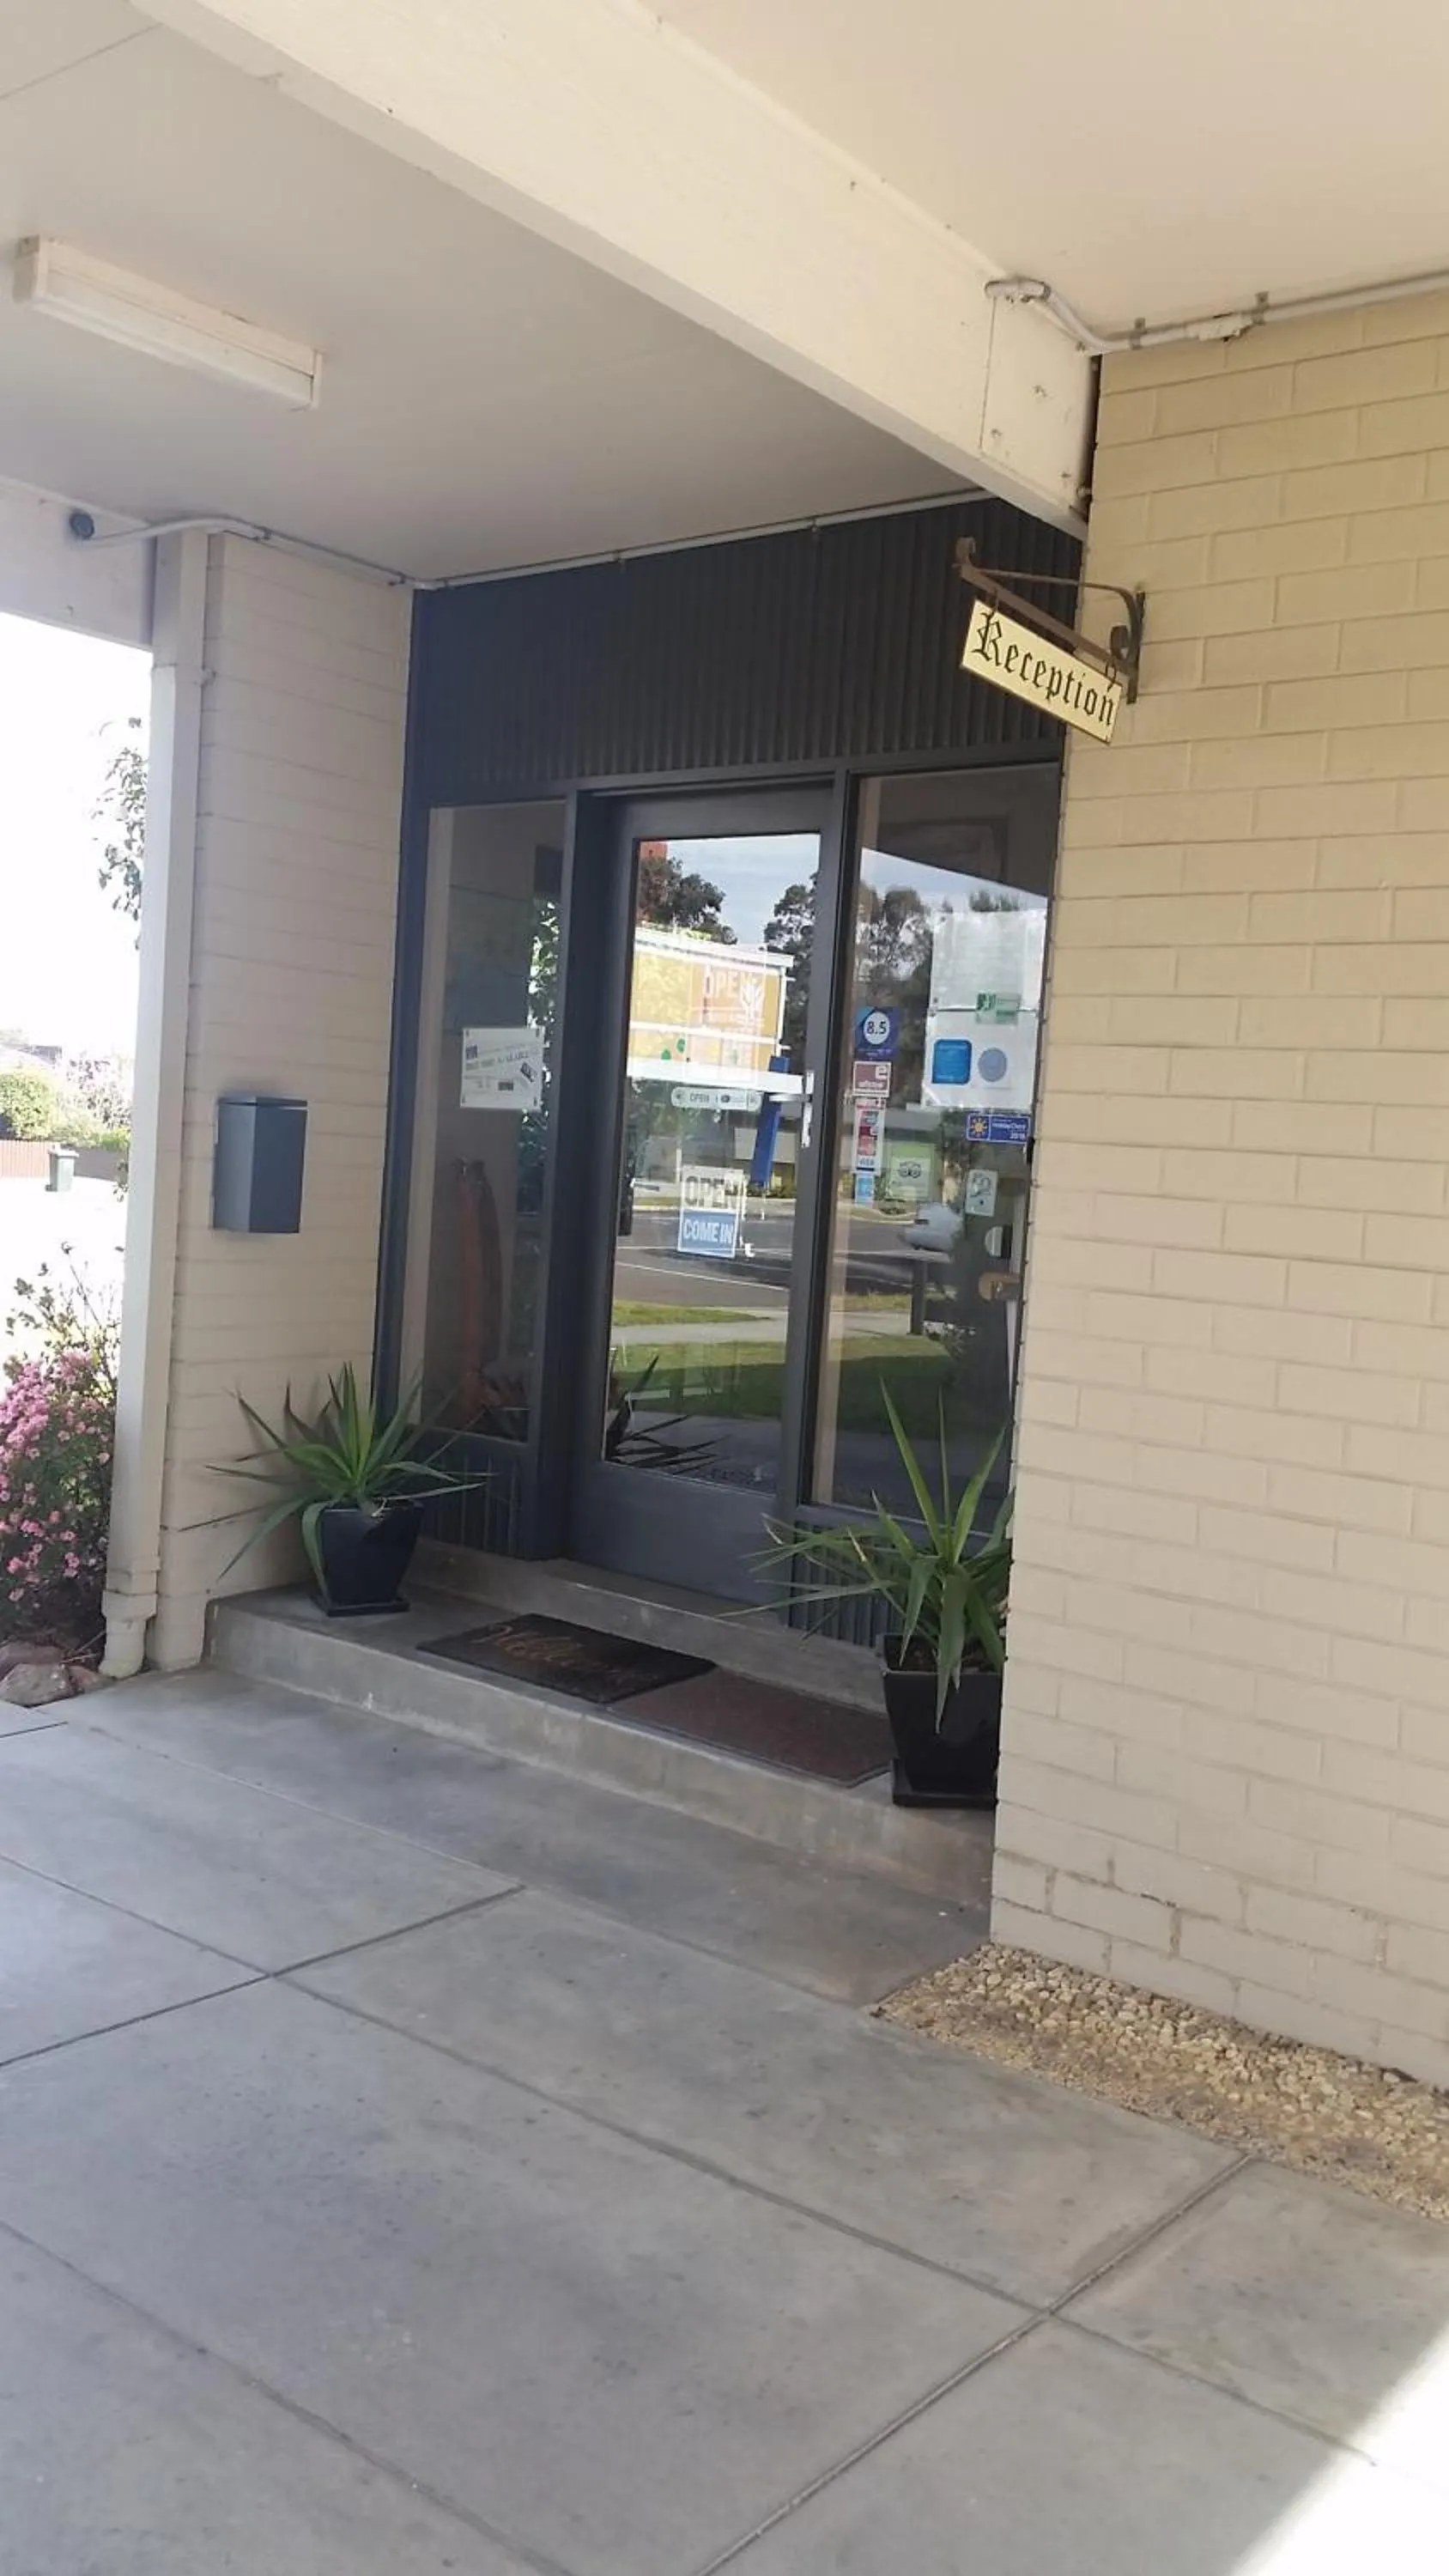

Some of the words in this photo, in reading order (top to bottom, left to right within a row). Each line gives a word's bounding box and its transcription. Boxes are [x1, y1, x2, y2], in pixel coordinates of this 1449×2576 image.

[971, 611, 1114, 726] Reception
[867, 1021, 887, 1035] 8.5
[683, 1218, 719, 1242] COME
[719, 1224, 734, 1244] IN
